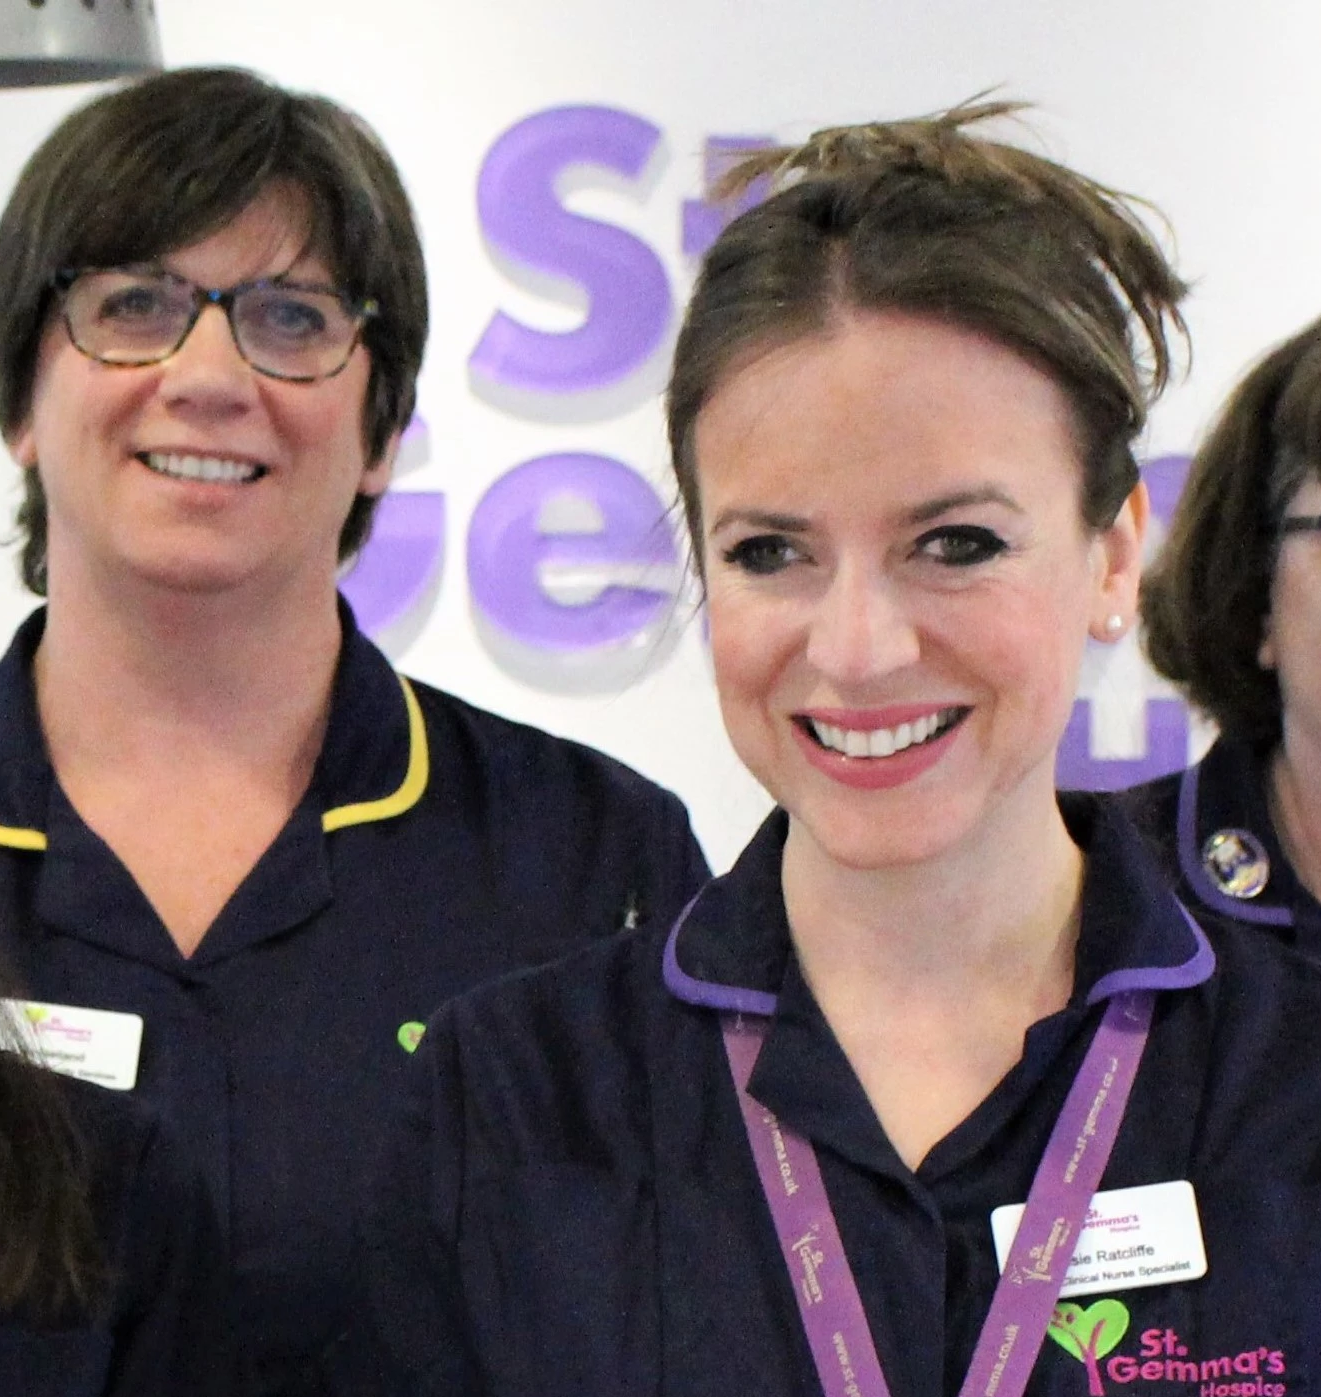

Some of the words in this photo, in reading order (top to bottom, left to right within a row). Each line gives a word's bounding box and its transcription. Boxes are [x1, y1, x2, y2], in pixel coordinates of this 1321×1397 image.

[1083, 1214, 1139, 1229] emma's
[1096, 1245, 1155, 1263] Ratcliffe
[1103, 1270, 1135, 1281] Nurse
[1139, 1261, 1191, 1277] Specialist
[1140, 1328, 1188, 1357] St.
[1107, 1347, 1286, 1383] Gemma's
